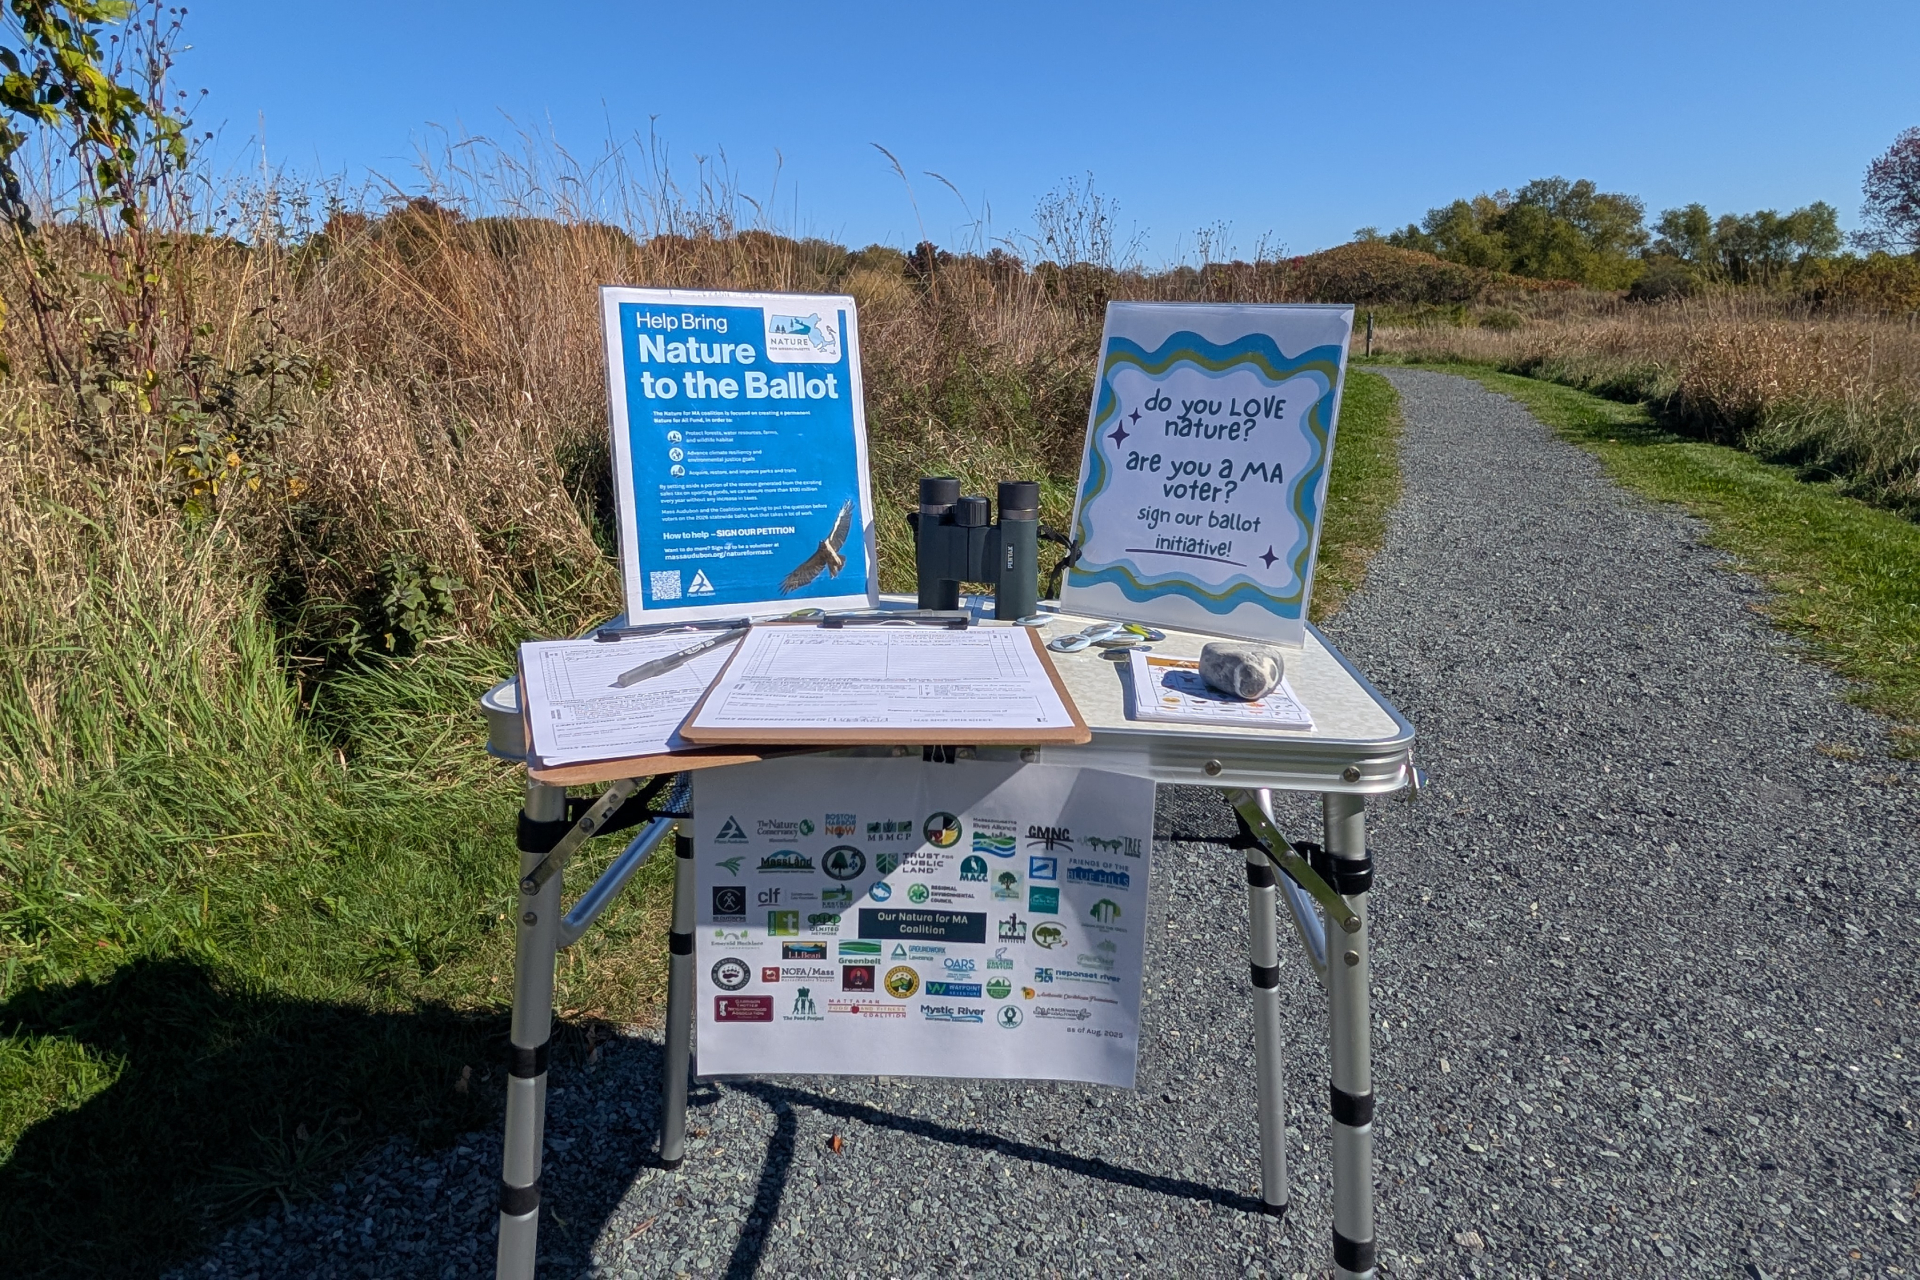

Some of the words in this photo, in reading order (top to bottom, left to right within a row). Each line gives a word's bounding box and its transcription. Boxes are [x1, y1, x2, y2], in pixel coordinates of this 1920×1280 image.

[636, 312, 678, 332] Help
[681, 313, 728, 334] Bring
[770, 338, 809, 346] NATURE
[639, 334, 756, 364] Nature
[640, 371, 678, 399] to
[682, 370, 739, 399] the
[744, 371, 839, 399] Ballot
[1144, 387, 1172, 412] do
[1176, 399, 1222, 420] you
[1229, 395, 1286, 420] LOVE
[1165, 418, 1257, 442] nature?
[1126, 451, 1161, 472] are
[1166, 460, 1211, 481] you
[1218, 458, 1233, 479] a
[1240, 462, 1283, 484] MA
[1163, 480, 1238, 503] voter?
[1137, 506, 1170, 530] sign
[1175, 511, 1203, 527] our
[1208, 510, 1261, 533] ballot
[663, 532, 681, 540] How
[691, 530, 709, 539] help
[716, 529, 737, 537] SIGN
[738, 528, 756, 536] OUR
[757, 526, 795, 535] PETITION
[1155, 534, 1232, 557] initiative!
[757, 820, 769, 828] The
[769, 819, 798, 829] Nature
[991, 823, 1017, 831] Alliance
[757, 828, 798, 838] Conservancy
[825, 826, 856, 836] NOW
[1124, 836, 1142, 854] TREE
[761, 856, 813, 867] MassLand
[903, 852, 939, 860] TRUST
[903, 860, 944, 868] PUBLIC
[1069, 858, 1100, 868] FRIENDS
[1103, 861, 1113, 869] OF
[1114, 863, 1129, 871] THE
[960, 873, 988, 882] MACC
[1067, 870, 1095, 882] BLUE
[1099, 874, 1129, 887] HILLS
[758, 888, 781, 904] clf
[878, 912, 896, 921] Our
[899, 912, 932, 922] Nature
[936, 914, 950, 923] for
[952, 915, 968, 924] MA
[900, 924, 945, 935] Coalition
[838, 957, 881, 965] Greenbelt
[944, 958, 976, 970] OARS
[781, 967, 835, 978] NOFA/Mass
[1056, 969, 1097, 979] neponset
[1100, 974, 1121, 983] river
[921, 1005, 954, 1015] Mystic
[958, 1007, 986, 1016] River
[1104, 1030, 1124, 1039] 2025
